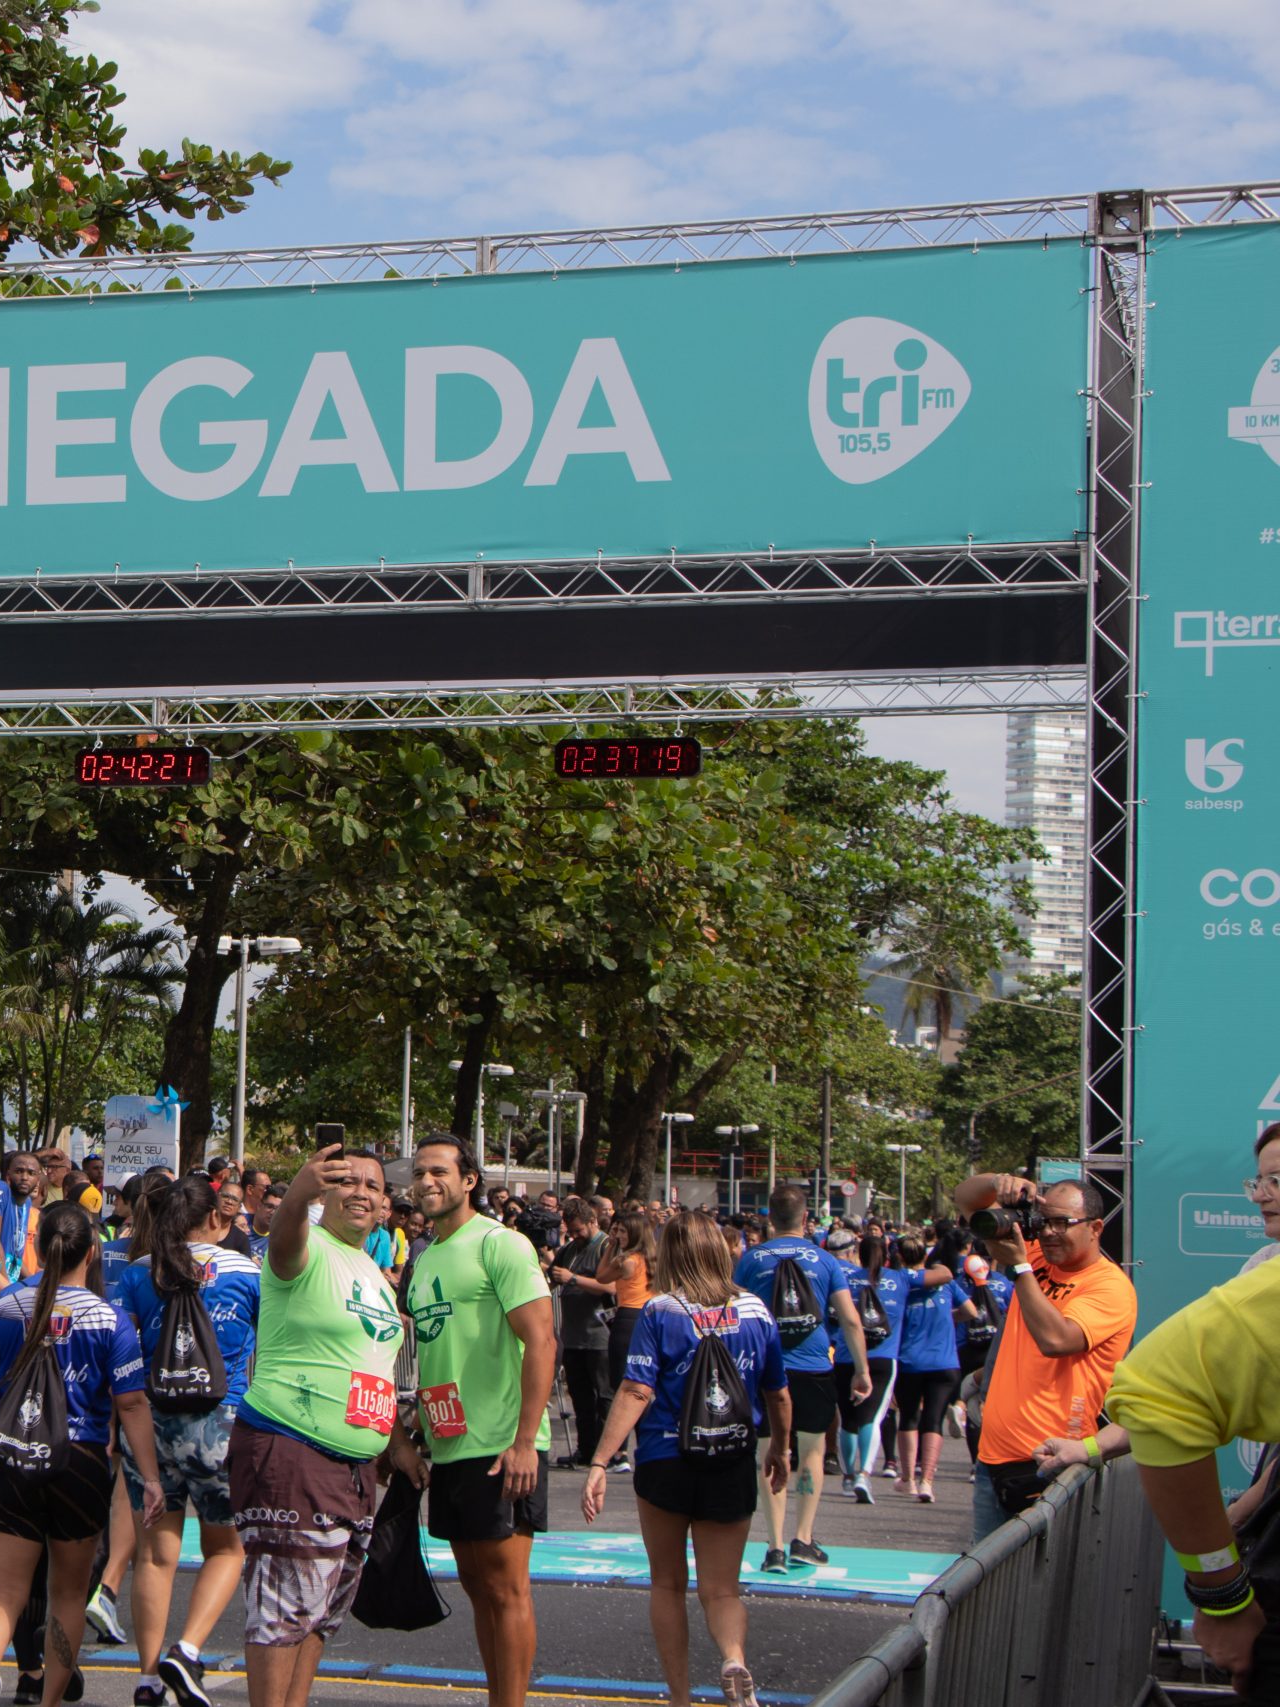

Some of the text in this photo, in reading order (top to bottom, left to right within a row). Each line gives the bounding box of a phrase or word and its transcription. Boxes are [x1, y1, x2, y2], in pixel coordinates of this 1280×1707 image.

[826, 338, 955, 429] tri FM
[1245, 416, 1257, 428] 10
[838, 432, 891, 455] 105,5
[81, 754, 193, 780] 02:42:21
[1184, 796, 1244, 812] sabesp
[1203, 918, 1242, 940] gás
[1249, 918, 1264, 936] &
[111, 1153, 168, 1166] IMÓVEL NÃO
[145, 1145, 162, 1155] SEU
